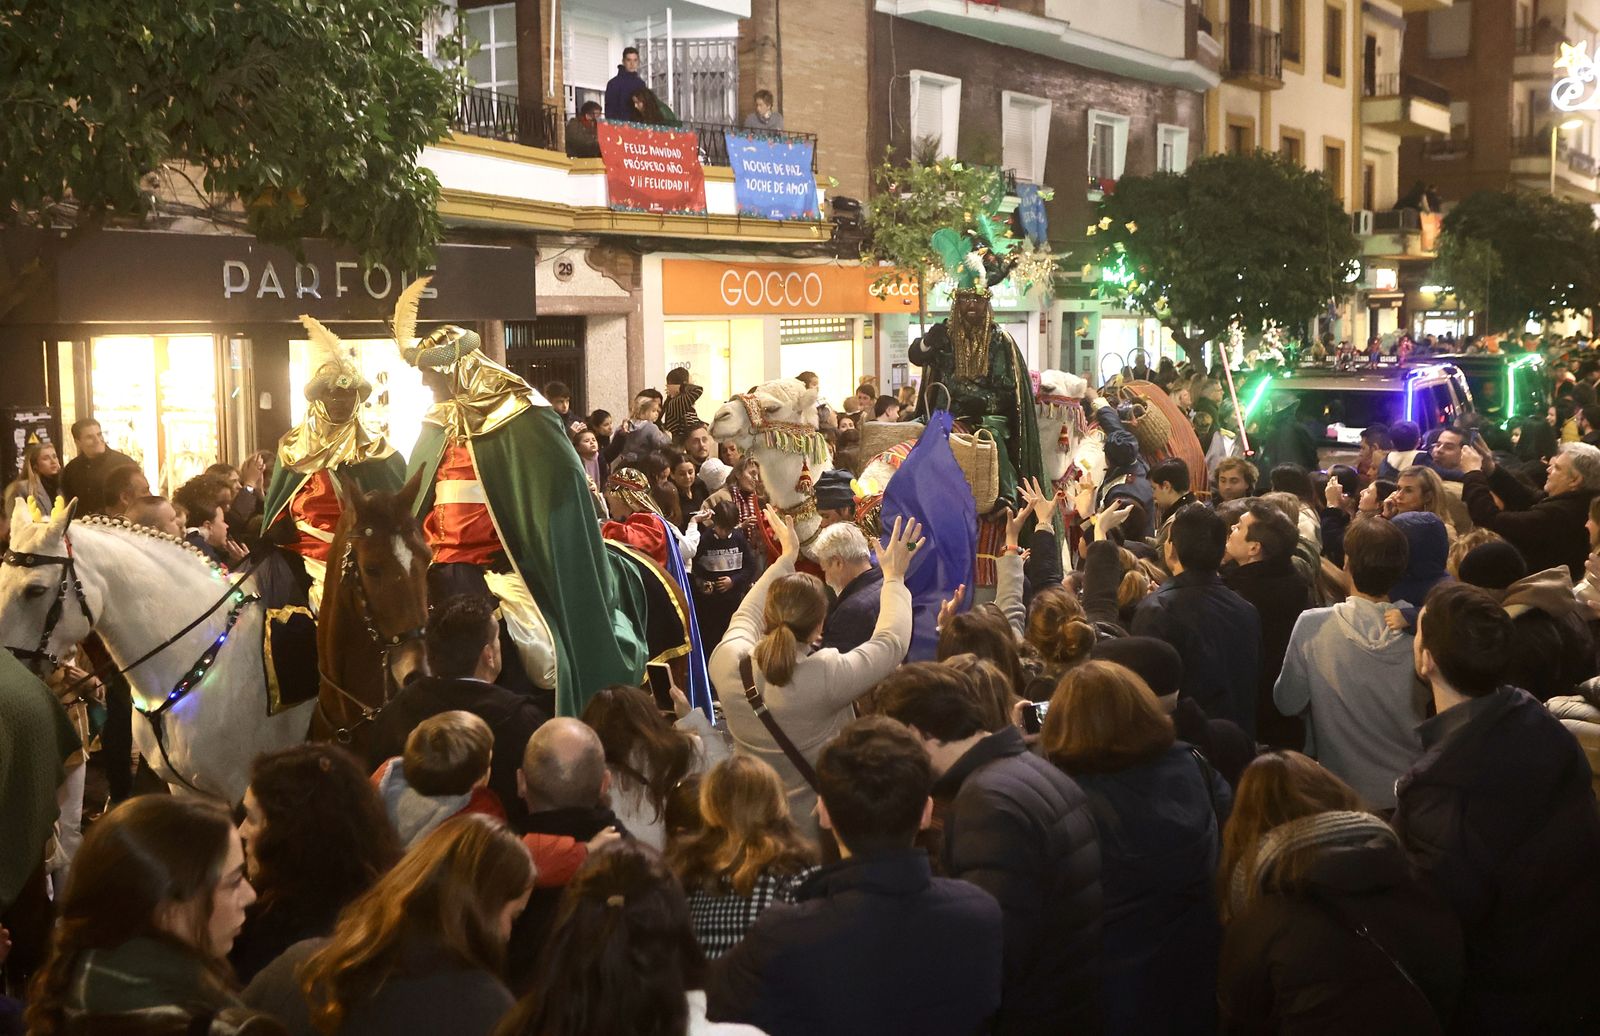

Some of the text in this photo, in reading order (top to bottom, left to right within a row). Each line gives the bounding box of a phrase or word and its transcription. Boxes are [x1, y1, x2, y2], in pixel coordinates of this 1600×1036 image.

[624, 142, 684, 159] FELIZ NAVIDAD,
[624, 156, 665, 172] PRÓSPERO
[743, 159, 772, 174] NOCHE
[773, 162, 785, 175] DE
[630, 175, 635, 187] Y
[644, 177, 683, 191] FELICIDAD
[773, 181, 785, 194] DE
[558, 262, 573, 276] 29
[720, 269, 823, 306] GOCCO
